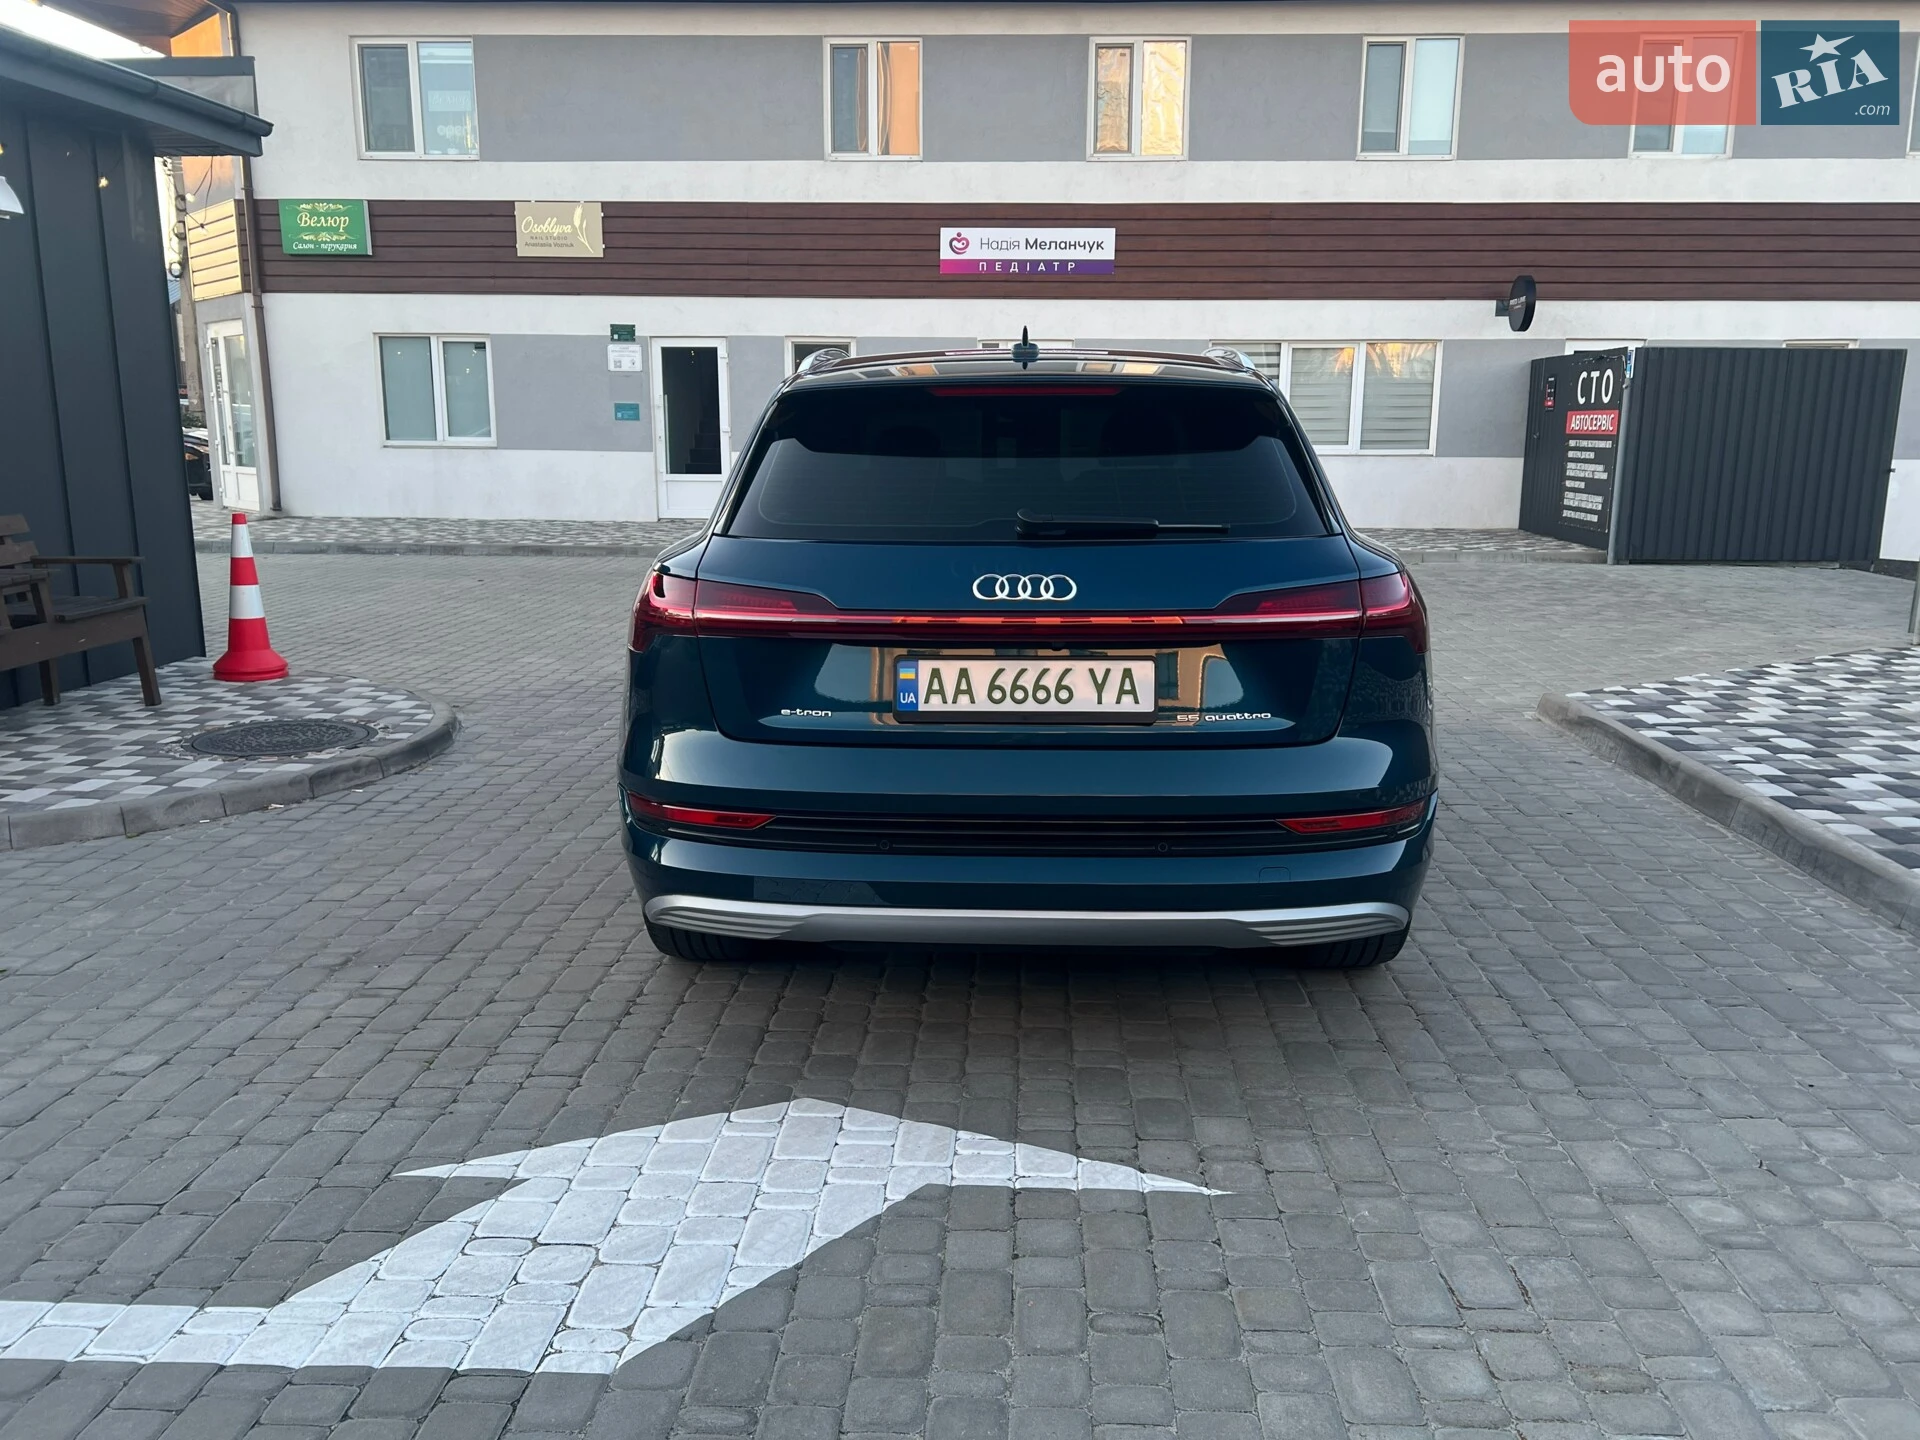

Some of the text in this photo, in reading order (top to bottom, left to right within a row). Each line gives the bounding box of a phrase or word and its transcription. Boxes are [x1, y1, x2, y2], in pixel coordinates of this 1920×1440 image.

[296, 212, 349, 232] Велюр
[521, 216, 573, 236] Osoblyva
[292, 241, 314, 250] Салон
[980, 237, 1104, 253] Надія Меланчук
[979, 262, 1076, 273] ПЕДІАТР
[1577, 368, 1614, 405] СТО
[1570, 413, 1615, 431] АВТОСЕРВІС
[923, 668, 1140, 704] AA 6666 YA
[900, 692, 916, 704] UA
[781, 708, 832, 717] e-tron
[1205, 713, 1271, 722] quattro
